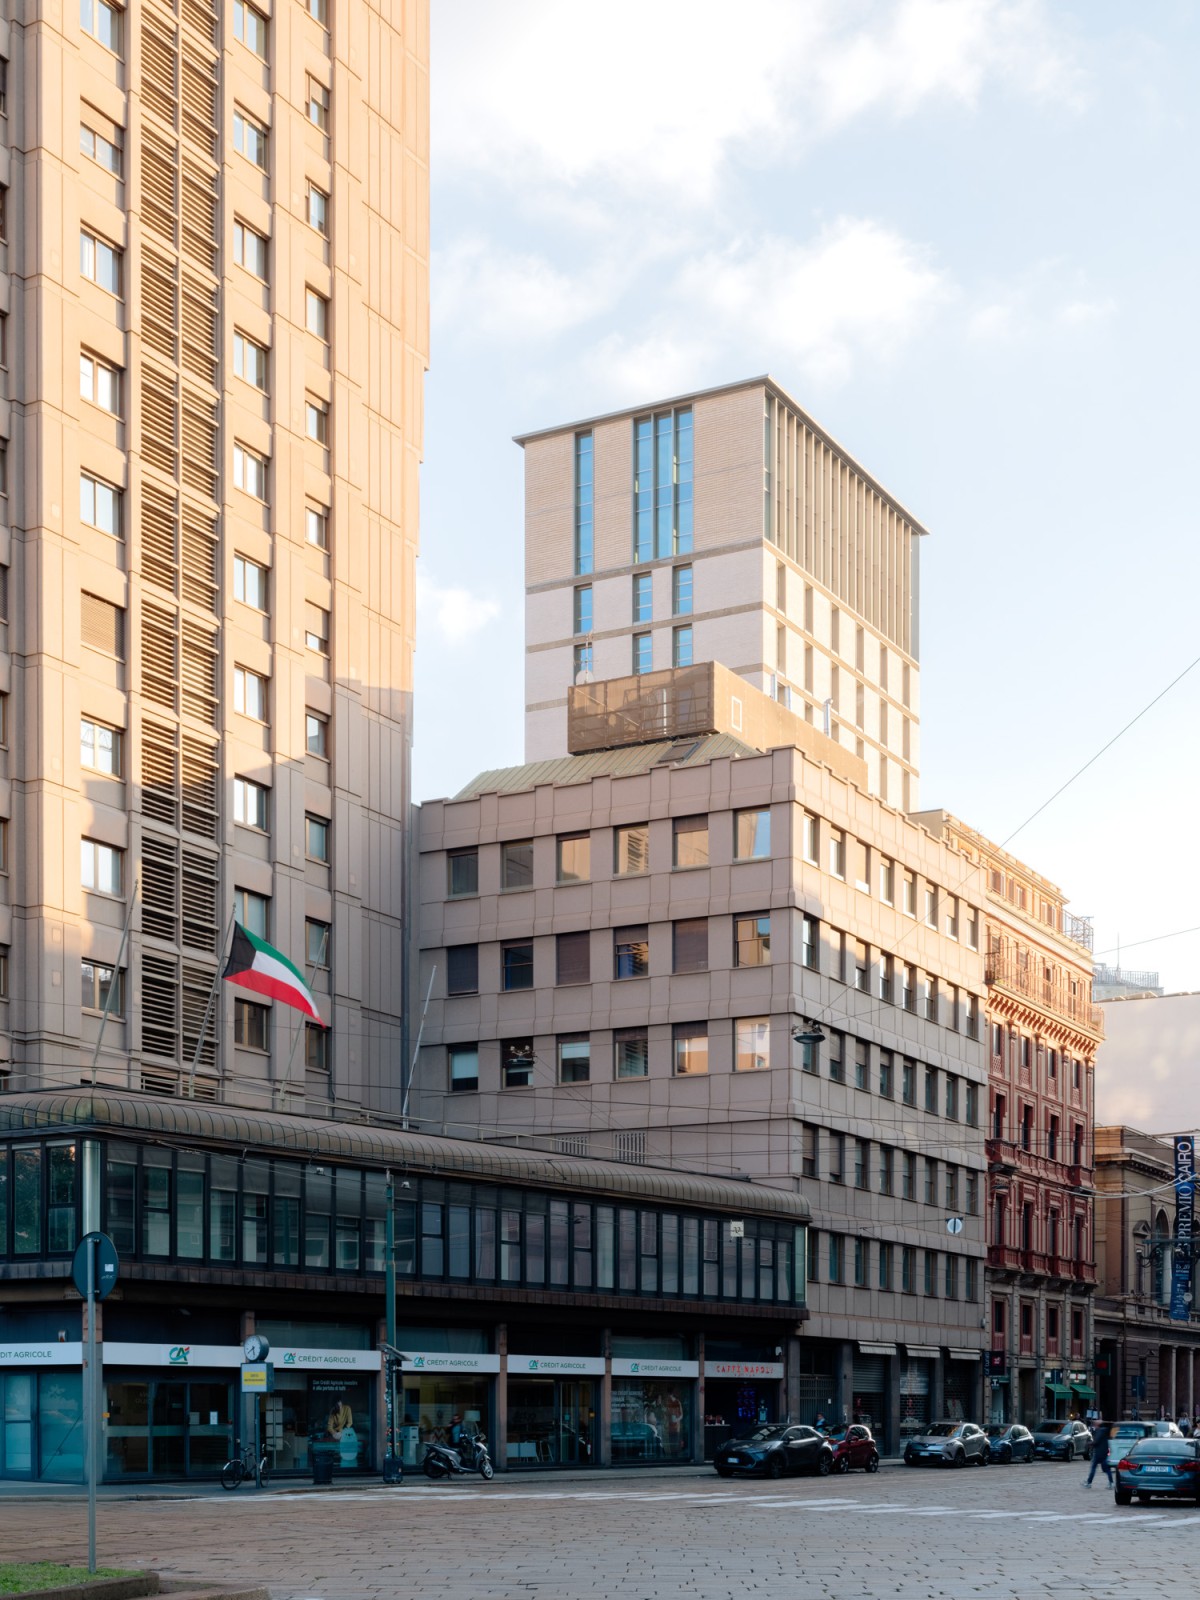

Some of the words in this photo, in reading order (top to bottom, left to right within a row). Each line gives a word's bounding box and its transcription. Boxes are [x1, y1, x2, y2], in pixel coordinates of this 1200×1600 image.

[1177, 1141, 1192, 1183] CAIRO
[1178, 1186, 1192, 1239] PREMIO
[324, 1356, 356, 1364] AGRICOLE
